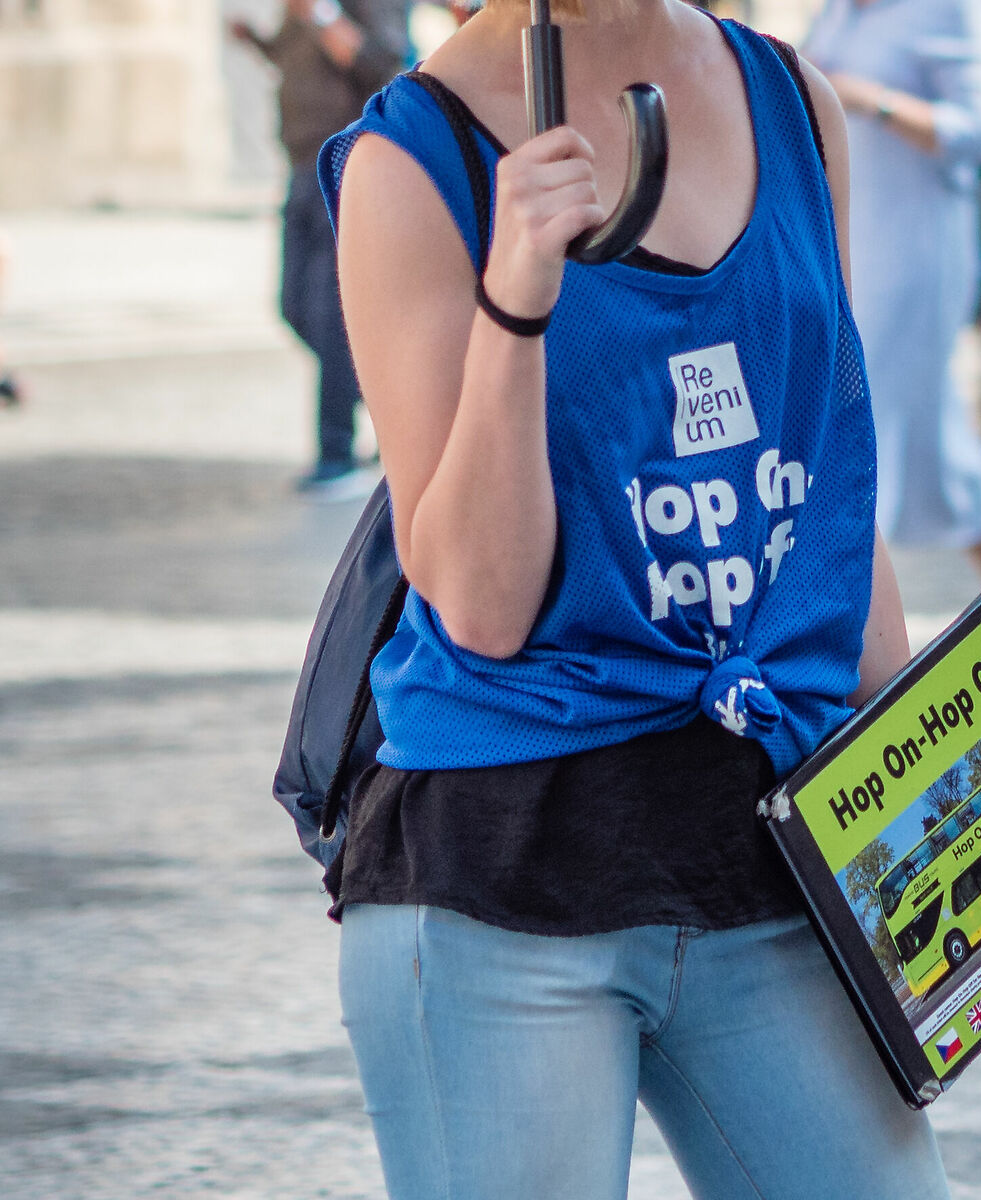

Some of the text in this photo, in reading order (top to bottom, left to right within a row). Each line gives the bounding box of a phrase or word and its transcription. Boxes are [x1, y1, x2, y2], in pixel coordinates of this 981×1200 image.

[680, 363, 713, 392] Re
[688, 386, 742, 417] veni
[685, 417, 726, 443] um
[625, 477, 738, 548] op
[828, 771, 885, 831] Hop
[882, 688, 974, 779] On-Hop
[952, 835, 975, 860] Hop
